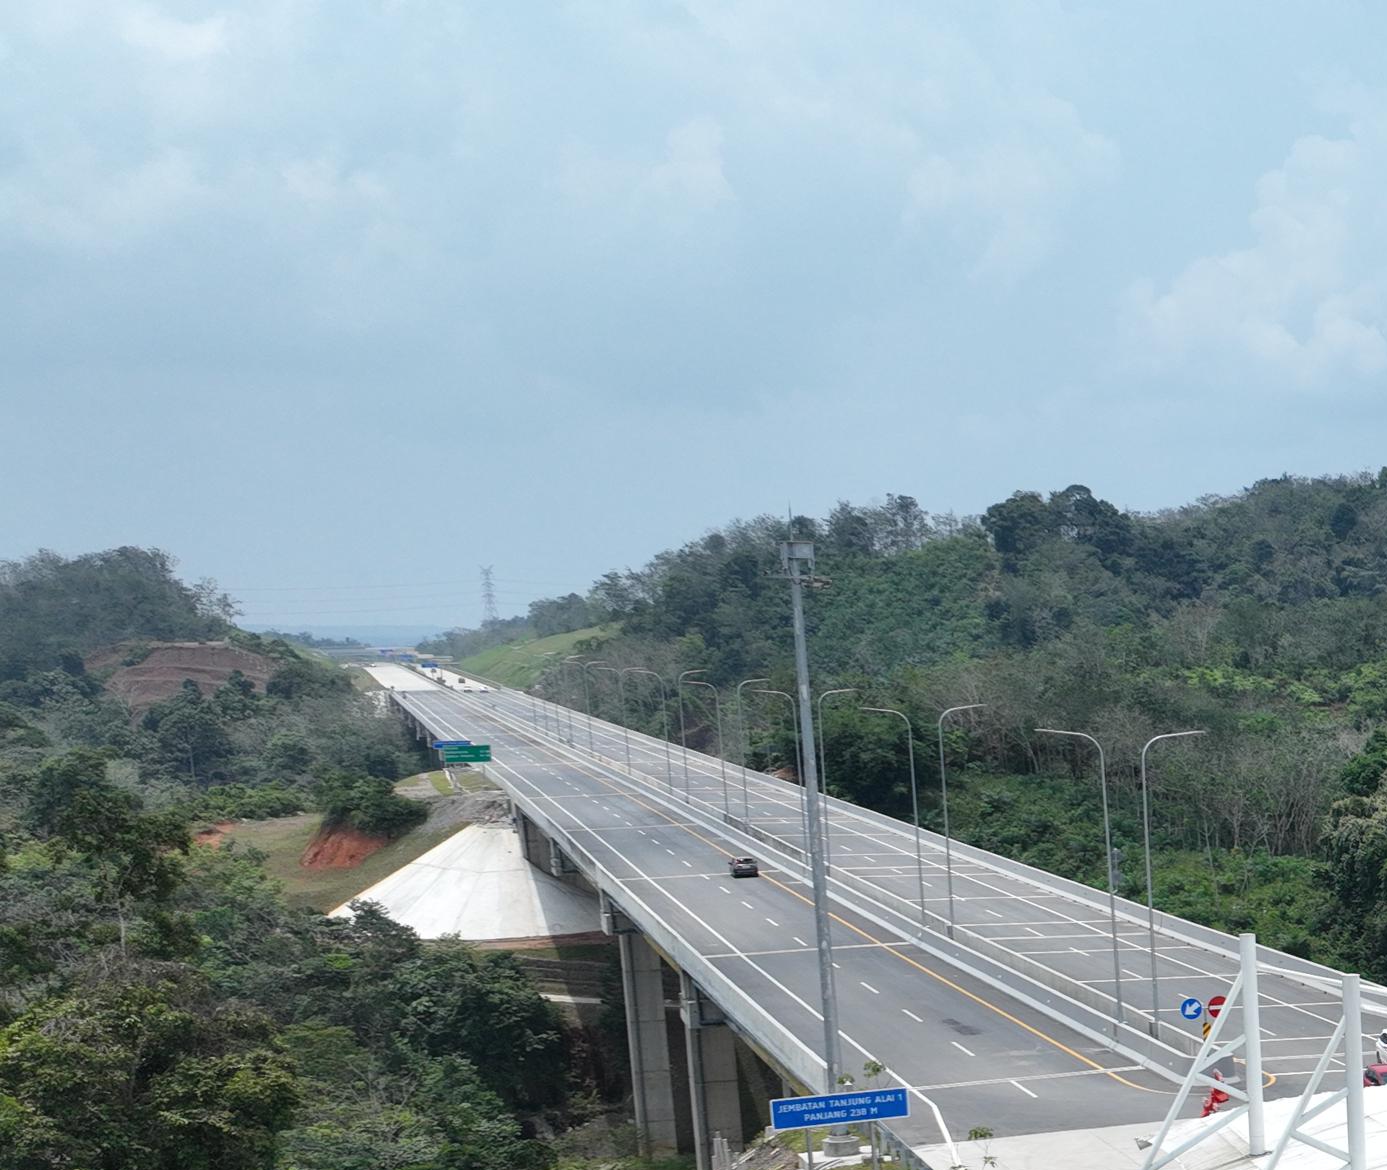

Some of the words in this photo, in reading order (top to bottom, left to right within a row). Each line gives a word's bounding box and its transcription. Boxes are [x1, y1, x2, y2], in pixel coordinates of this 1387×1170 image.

[778, 1101, 825, 1113] JEMBATAN
[829, 1096, 871, 1107] TANJUNG
[875, 1094, 895, 1103] ALAI
[804, 1110, 847, 1121] PANJANG
[870, 1106, 878, 1115] M
